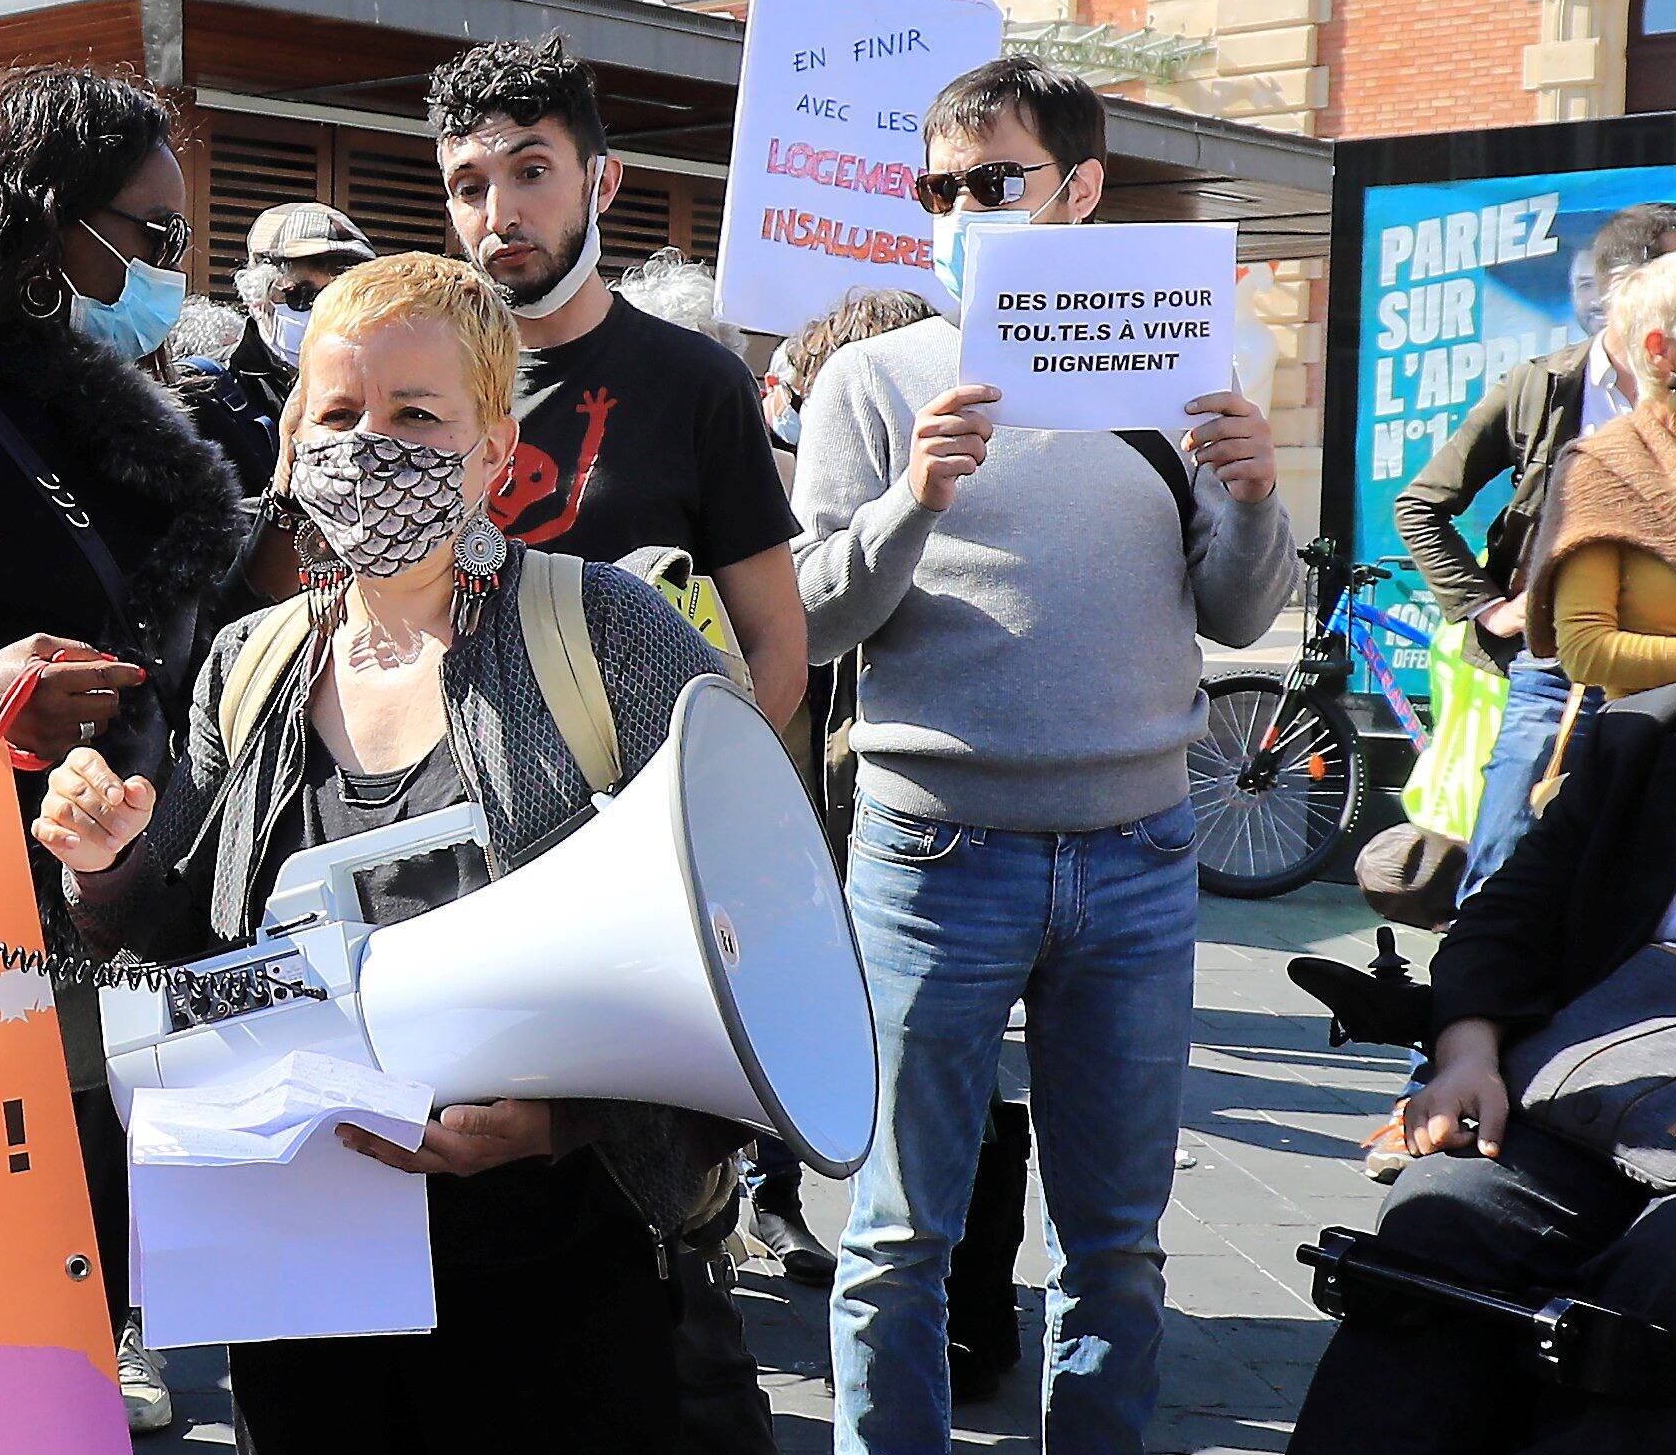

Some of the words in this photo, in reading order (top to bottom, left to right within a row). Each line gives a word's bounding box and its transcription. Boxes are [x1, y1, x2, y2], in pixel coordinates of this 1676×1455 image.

[794, 47, 827, 72] EN
[852, 28, 931, 63] FINIR
[797, 93, 851, 122] AVEC
[878, 111, 919, 133] LES
[766, 138, 929, 201] LOGEMEN
[761, 207, 935, 270] INSALUBRE
[1380, 192, 1560, 287] PARIEZ
[998, 294, 1047, 310] DES
[1056, 292, 1145, 310] DROITS
[1154, 290, 1212, 307] POUR
[1377, 278, 1477, 352] SUR
[998, 324, 1111, 342] TOU.TE.S
[1119, 319, 1135, 340] À
[1144, 321, 1211, 339] VIVRE
[1033, 353, 1179, 373] DIGNEMENT
